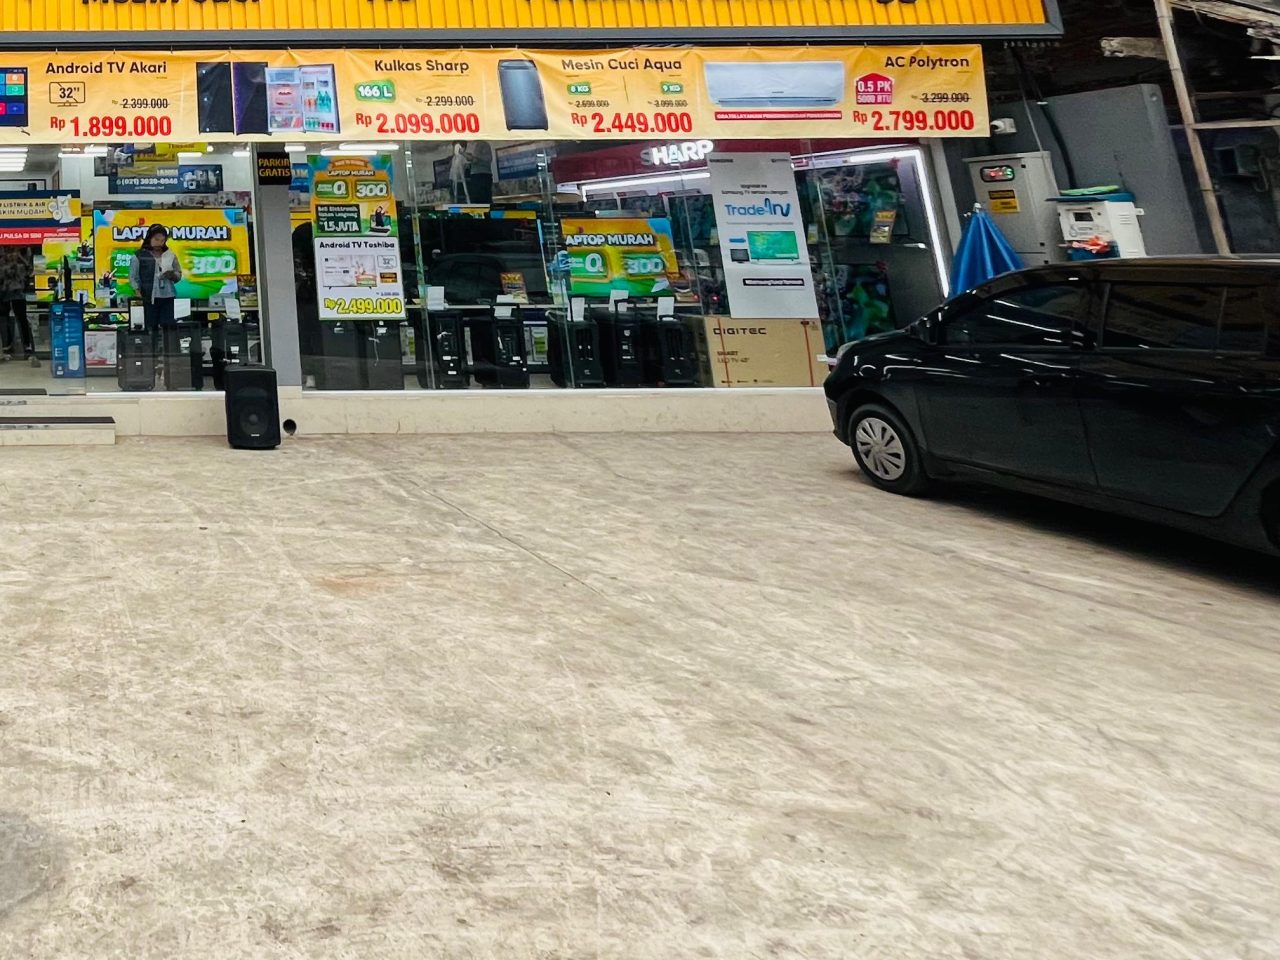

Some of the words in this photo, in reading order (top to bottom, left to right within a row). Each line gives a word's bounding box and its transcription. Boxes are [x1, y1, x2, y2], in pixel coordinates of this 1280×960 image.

[45, 61, 103, 74] Android
[107, 61, 125, 74] TV
[130, 61, 167, 74] Akari
[374, 59, 422, 72] Kulkas
[426, 59, 469, 73] Sharp
[562, 59, 605, 71] Mesin
[608, 58, 639, 70] Cuci
[643, 58, 682, 72] Aqua
[885, 56, 906, 68] AC
[909, 55, 969, 70] Polytron
[857, 80, 874, 92] 0.5
[876, 80, 891, 92] PK
[122, 98, 169, 109] 2.399.000
[426, 95, 475, 107] 2.299.000
[51, 116, 66, 131] Rp
[70, 116, 172, 137] 1.899.000
[356, 112, 373, 127] Rp
[376, 112, 480, 134] 2.099.000
[571, 112, 587, 127] Rp
[591, 112, 693, 133] 2.449.000
[853, 110, 867, 124] Rp
[871, 109, 974, 131] 2.799.000
[640, 140, 713, 166] SHARP
[258, 158, 290, 167] PARKIR
[259, 168, 290, 177] GRATIS
[356, 183, 388, 197] 300
[173, 226, 228, 239] MURAH
[335, 221, 360, 232] JUTA
[320, 241, 351, 249] Android
[363, 241, 395, 249] Toshiba
[607, 233, 654, 245] MURAH
[336, 298, 403, 315] 2.499.000
[713, 327, 767, 335] DIGITEC
